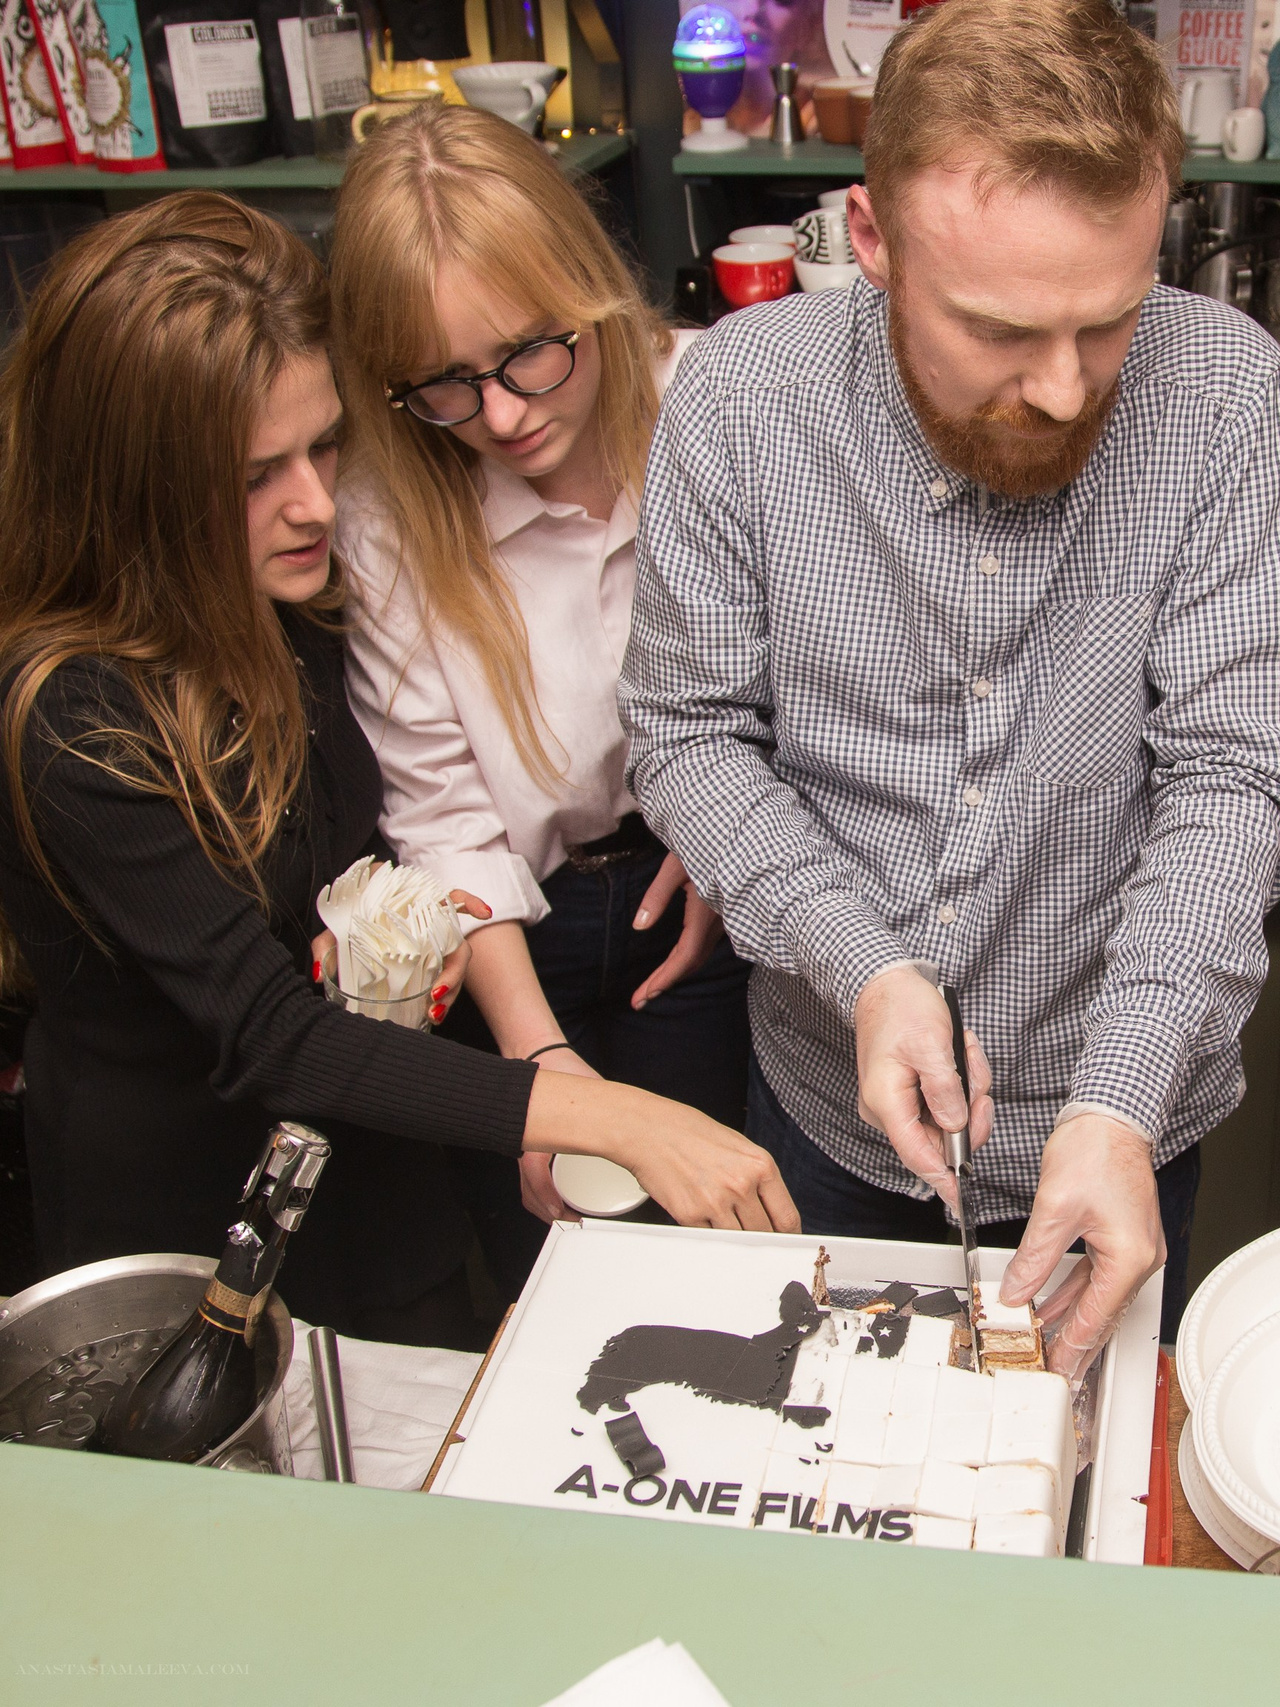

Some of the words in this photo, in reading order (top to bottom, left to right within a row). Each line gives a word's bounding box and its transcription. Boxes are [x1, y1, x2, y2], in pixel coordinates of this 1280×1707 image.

[1178, 10, 1246, 39] COFFEE
[1177, 39, 1243, 65] GUIDE
[555, 1464, 742, 1516] A-ONE
[753, 1491, 915, 1542] FILMS
